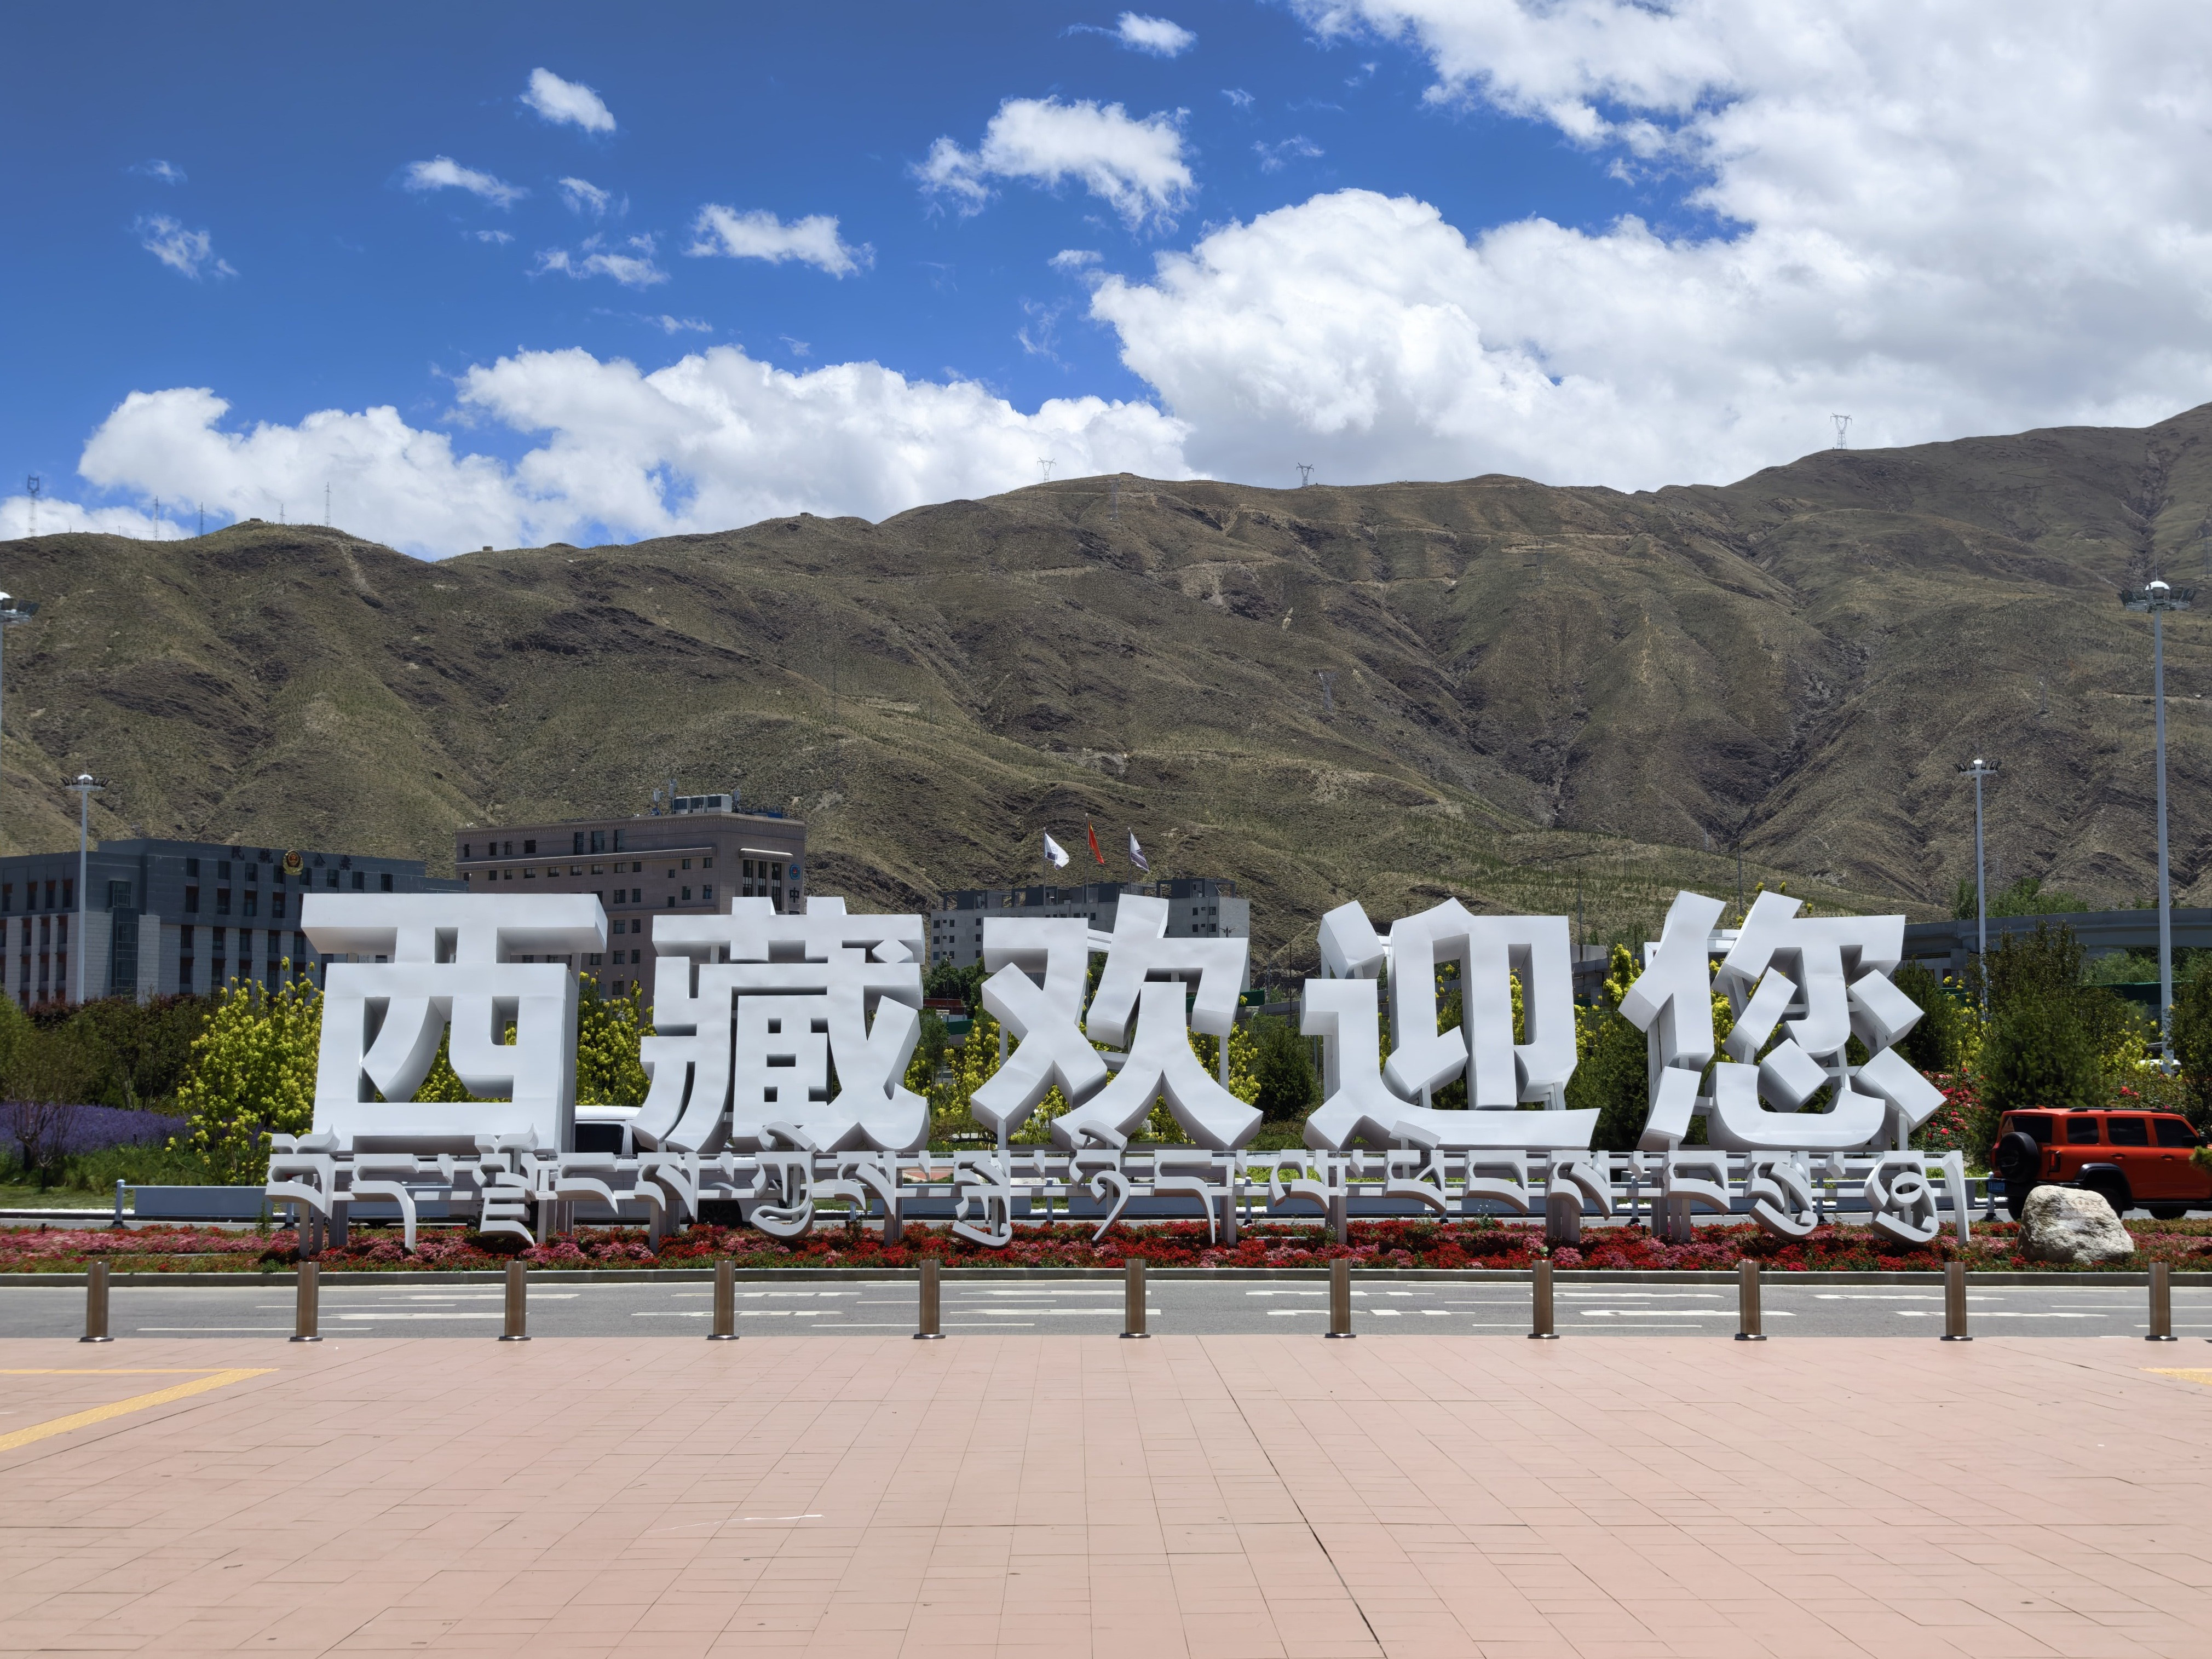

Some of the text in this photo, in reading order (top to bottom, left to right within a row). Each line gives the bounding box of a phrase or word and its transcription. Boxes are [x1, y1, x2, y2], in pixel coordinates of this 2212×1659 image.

[301, 890, 1947, 1157] 西藏欢迎您
